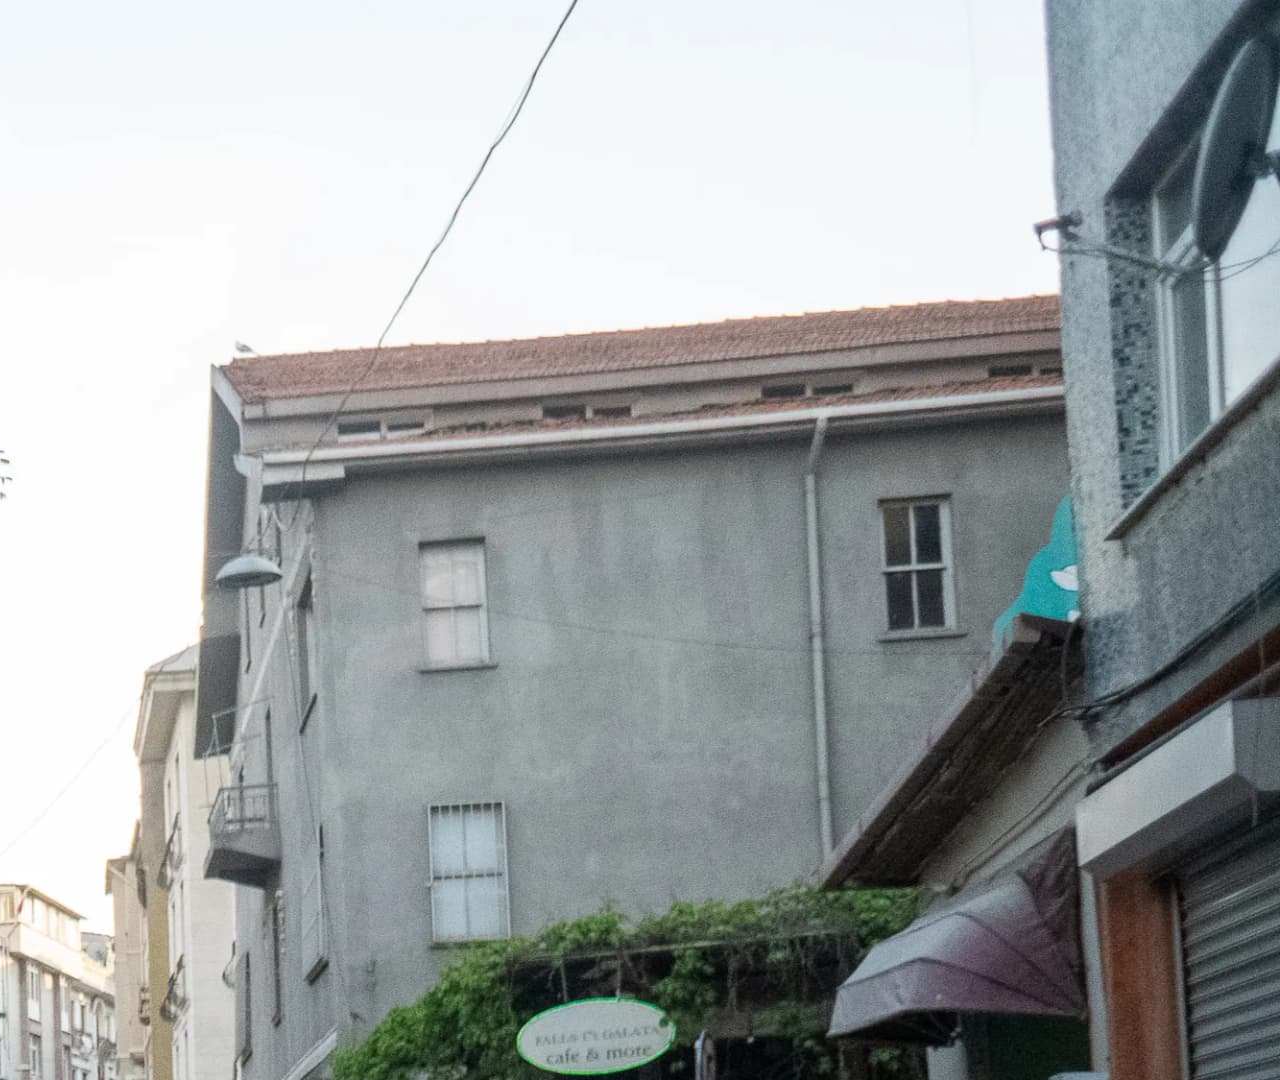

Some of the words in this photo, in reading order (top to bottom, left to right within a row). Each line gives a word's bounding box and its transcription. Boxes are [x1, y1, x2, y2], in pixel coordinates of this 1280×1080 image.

[546, 1047, 579, 1065] cafe
[586, 1048, 599, 1062] &
[606, 1045, 651, 1060] more
